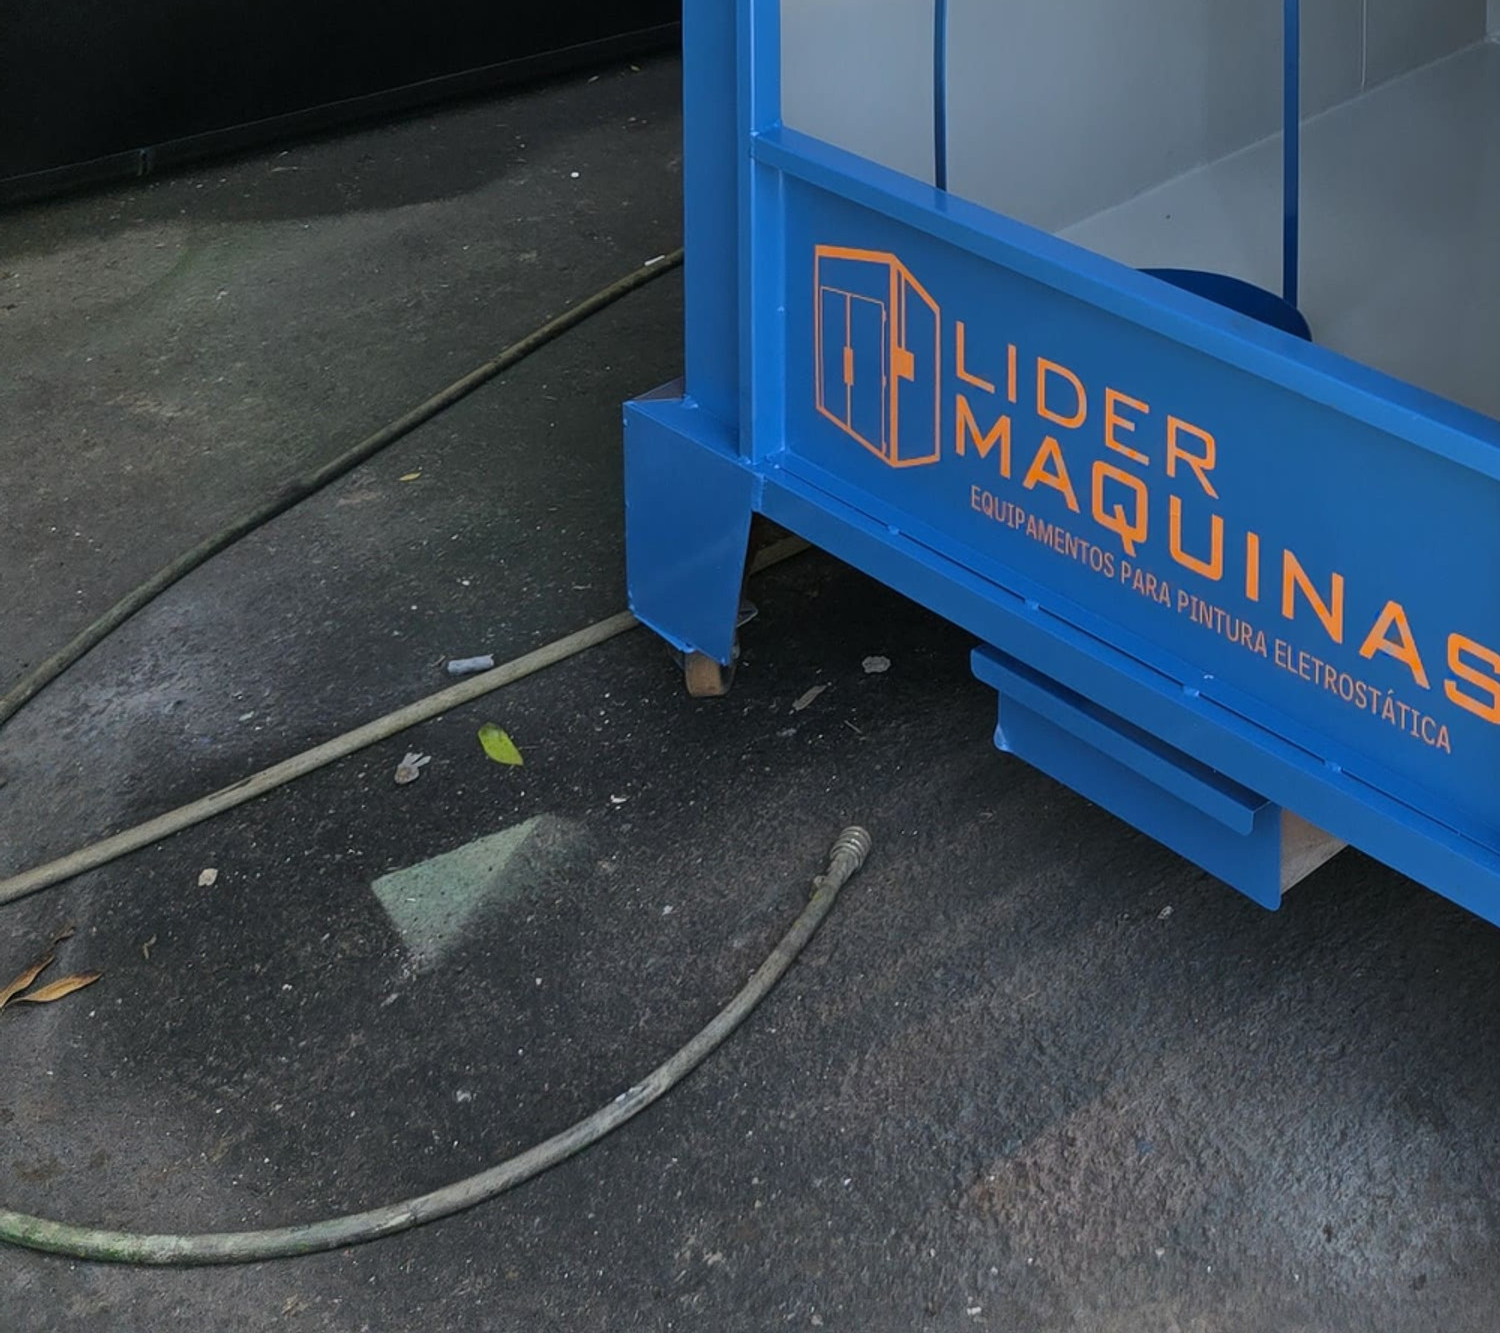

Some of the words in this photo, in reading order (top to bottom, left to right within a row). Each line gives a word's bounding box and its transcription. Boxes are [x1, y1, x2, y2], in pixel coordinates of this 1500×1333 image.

[955, 320, 1219, 499] LIDER
[970, 485, 1115, 578] EQUIPAMENTOS
[1120, 560, 1172, 608] PARA
[1177, 589, 1268, 659] PINTURA
[1274, 638, 1452, 755] ELETROSTÁTICA
